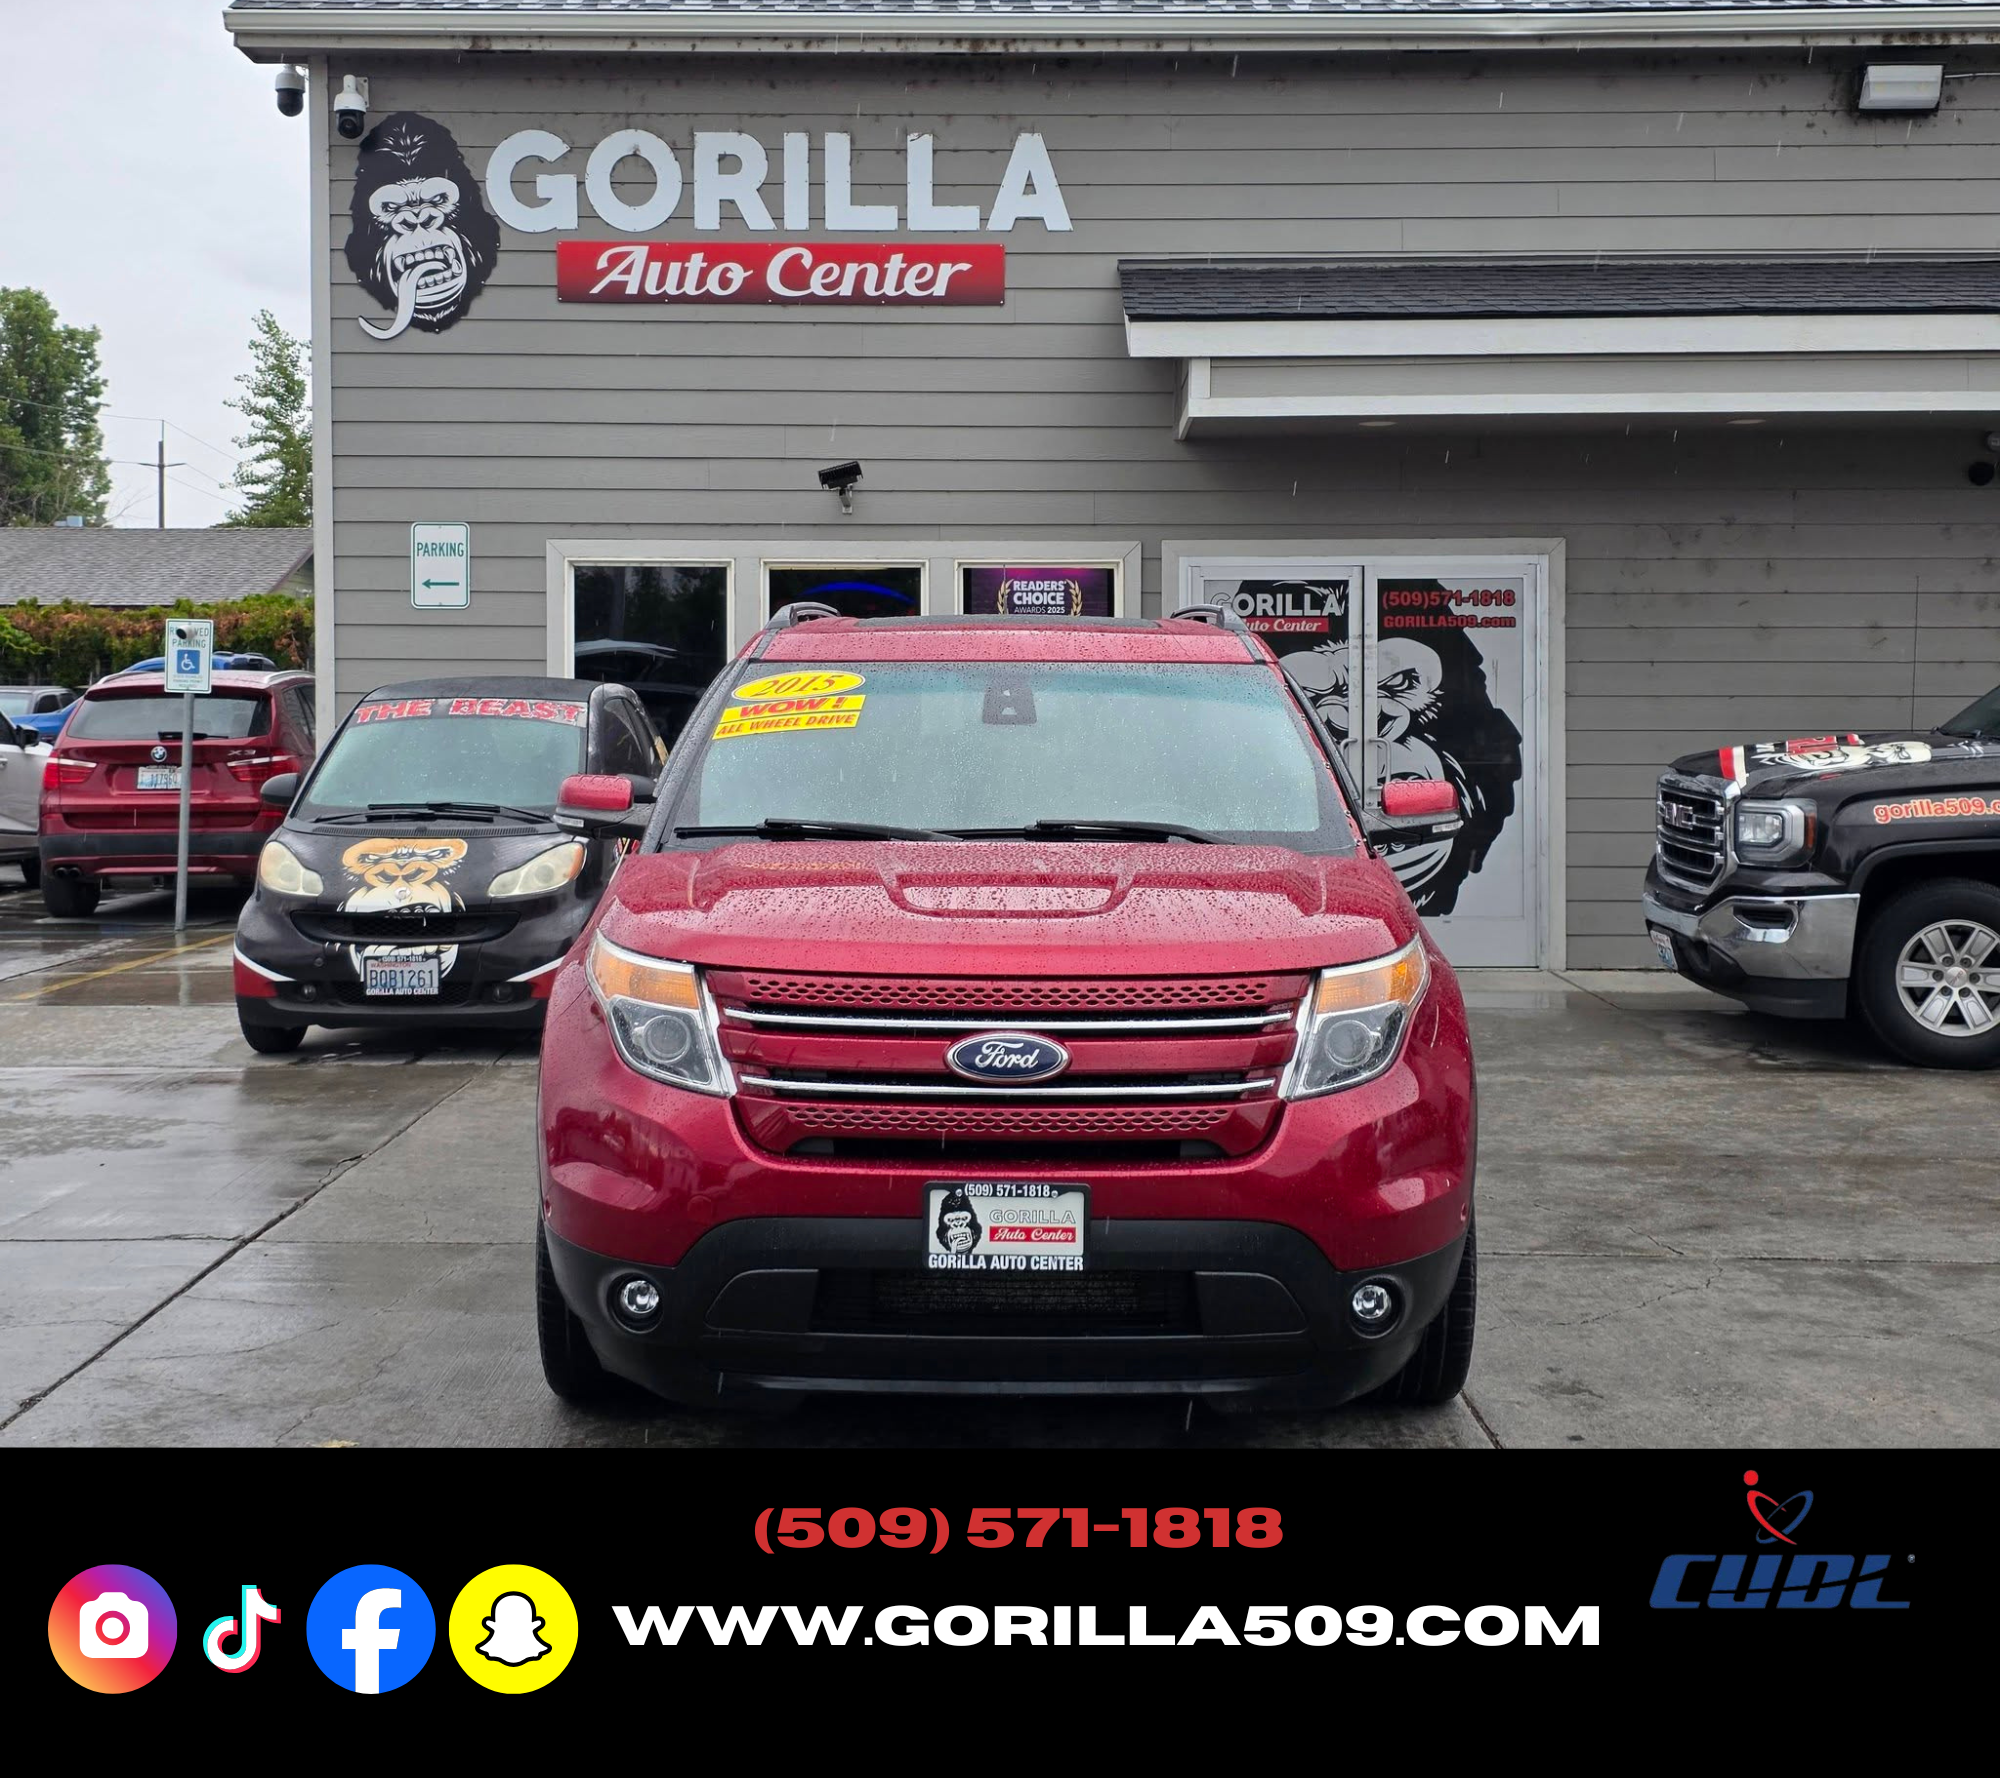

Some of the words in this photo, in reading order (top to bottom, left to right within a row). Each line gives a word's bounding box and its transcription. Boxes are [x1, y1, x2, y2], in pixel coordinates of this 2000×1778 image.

[485, 128, 1074, 233] GORILLA
[589, 244, 753, 297] Auto
[766, 245, 973, 298] Center
[416, 542, 465, 558] PARKING
[1012, 592, 1066, 605] CHOICE
[1382, 589, 1517, 610] (509)571-1818
[1014, 606, 1046, 614] AWARDS
[1047, 606, 1066, 614] 2025
[1244, 620, 1270, 632] uto
[1273, 618, 1322, 632] Center
[1383, 615, 1517, 628] GORILLA509.com
[172, 639, 207, 649] PARKING
[750, 674, 845, 697] 2015
[355, 699, 436, 723] THE
[449, 698, 587, 722] BEAST
[716, 724, 743, 736] ALL
[750, 716, 801, 732] WHEEL
[805, 714, 857, 726] DRIVE
[369, 969, 434, 988] BQB1261
[394, 987, 413, 995] AUTO
[413, 987, 439, 995] CENTER
[974, 1041, 1039, 1069] Ford
[964, 1183, 994, 1197] (509)
[996, 1184, 1050, 1197] 571-1818
[989, 1209, 1077, 1224] GORILLA
[993, 1227, 1027, 1240] Auto
[1030, 1228, 1075, 1241] Center
[990, 1255, 1027, 1270] AUTO
[1030, 1255, 1084, 1271] CENTER
